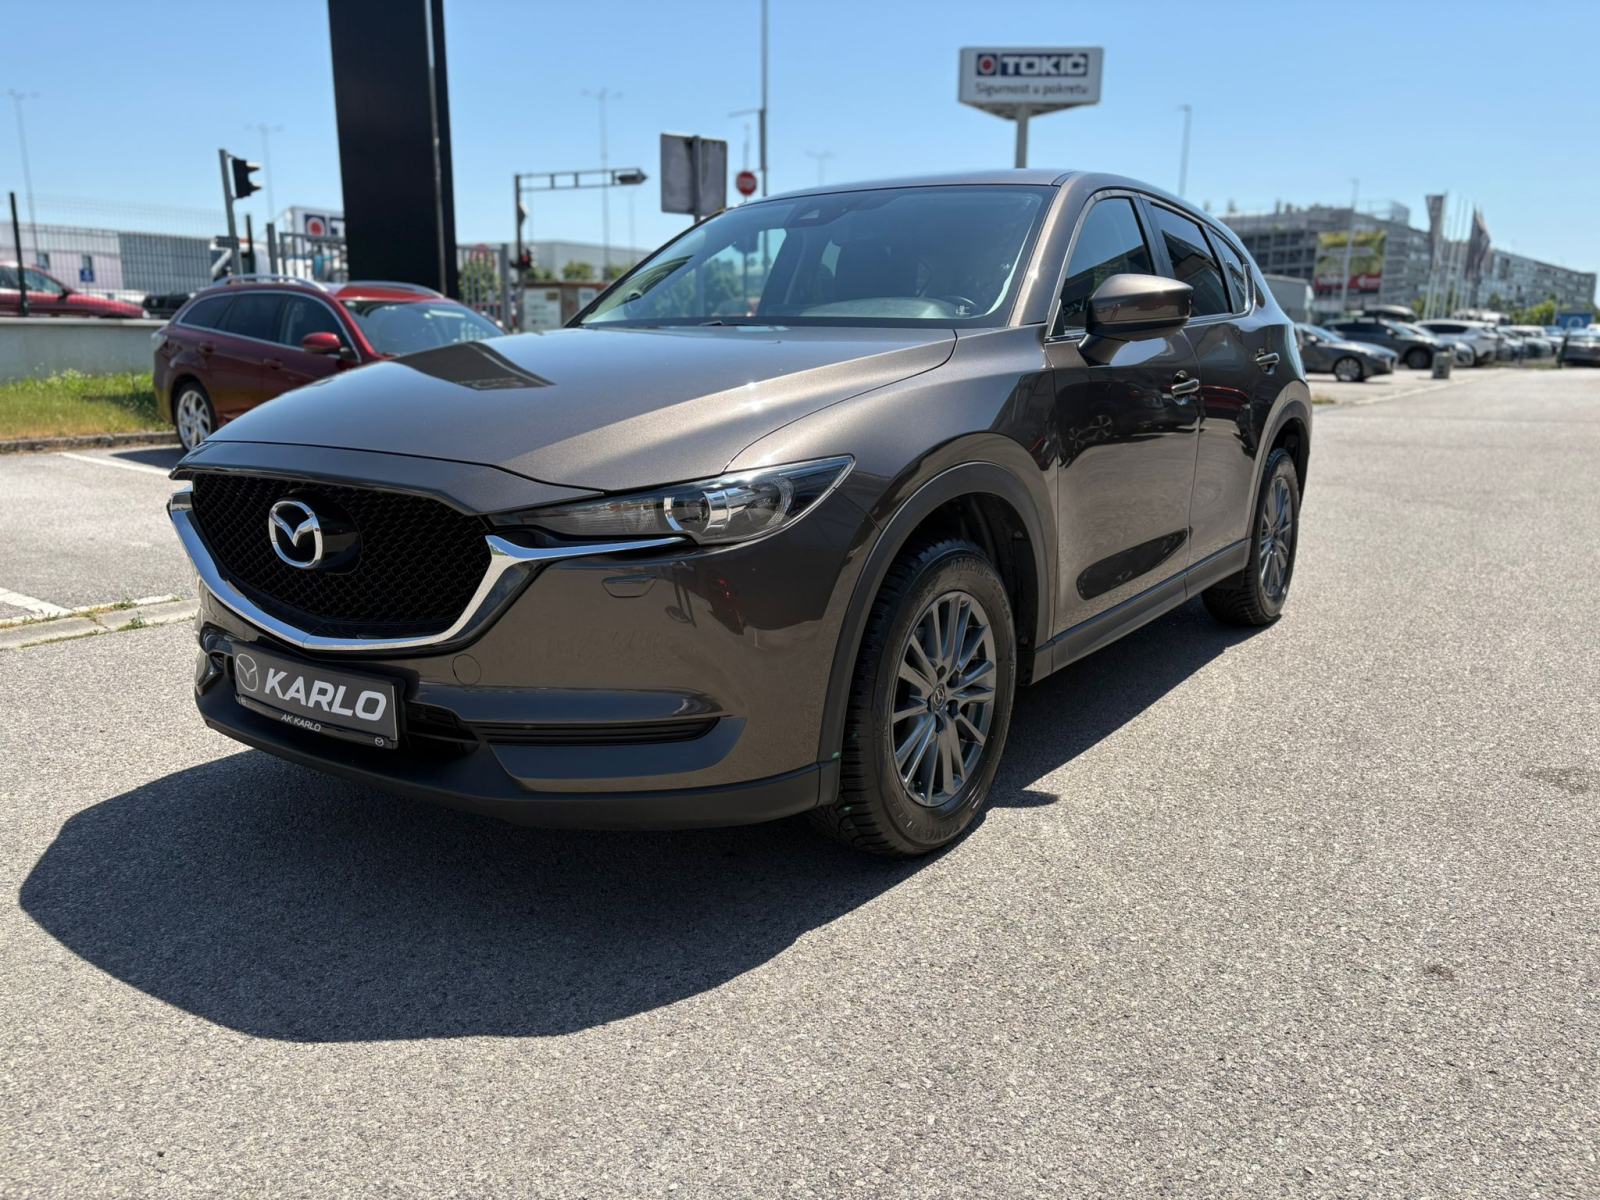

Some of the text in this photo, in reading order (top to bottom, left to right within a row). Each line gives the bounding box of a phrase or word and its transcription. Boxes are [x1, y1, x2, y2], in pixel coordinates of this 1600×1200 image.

[264, 667, 387, 721] KARLO
[281, 714, 322, 732] AK KARLO
